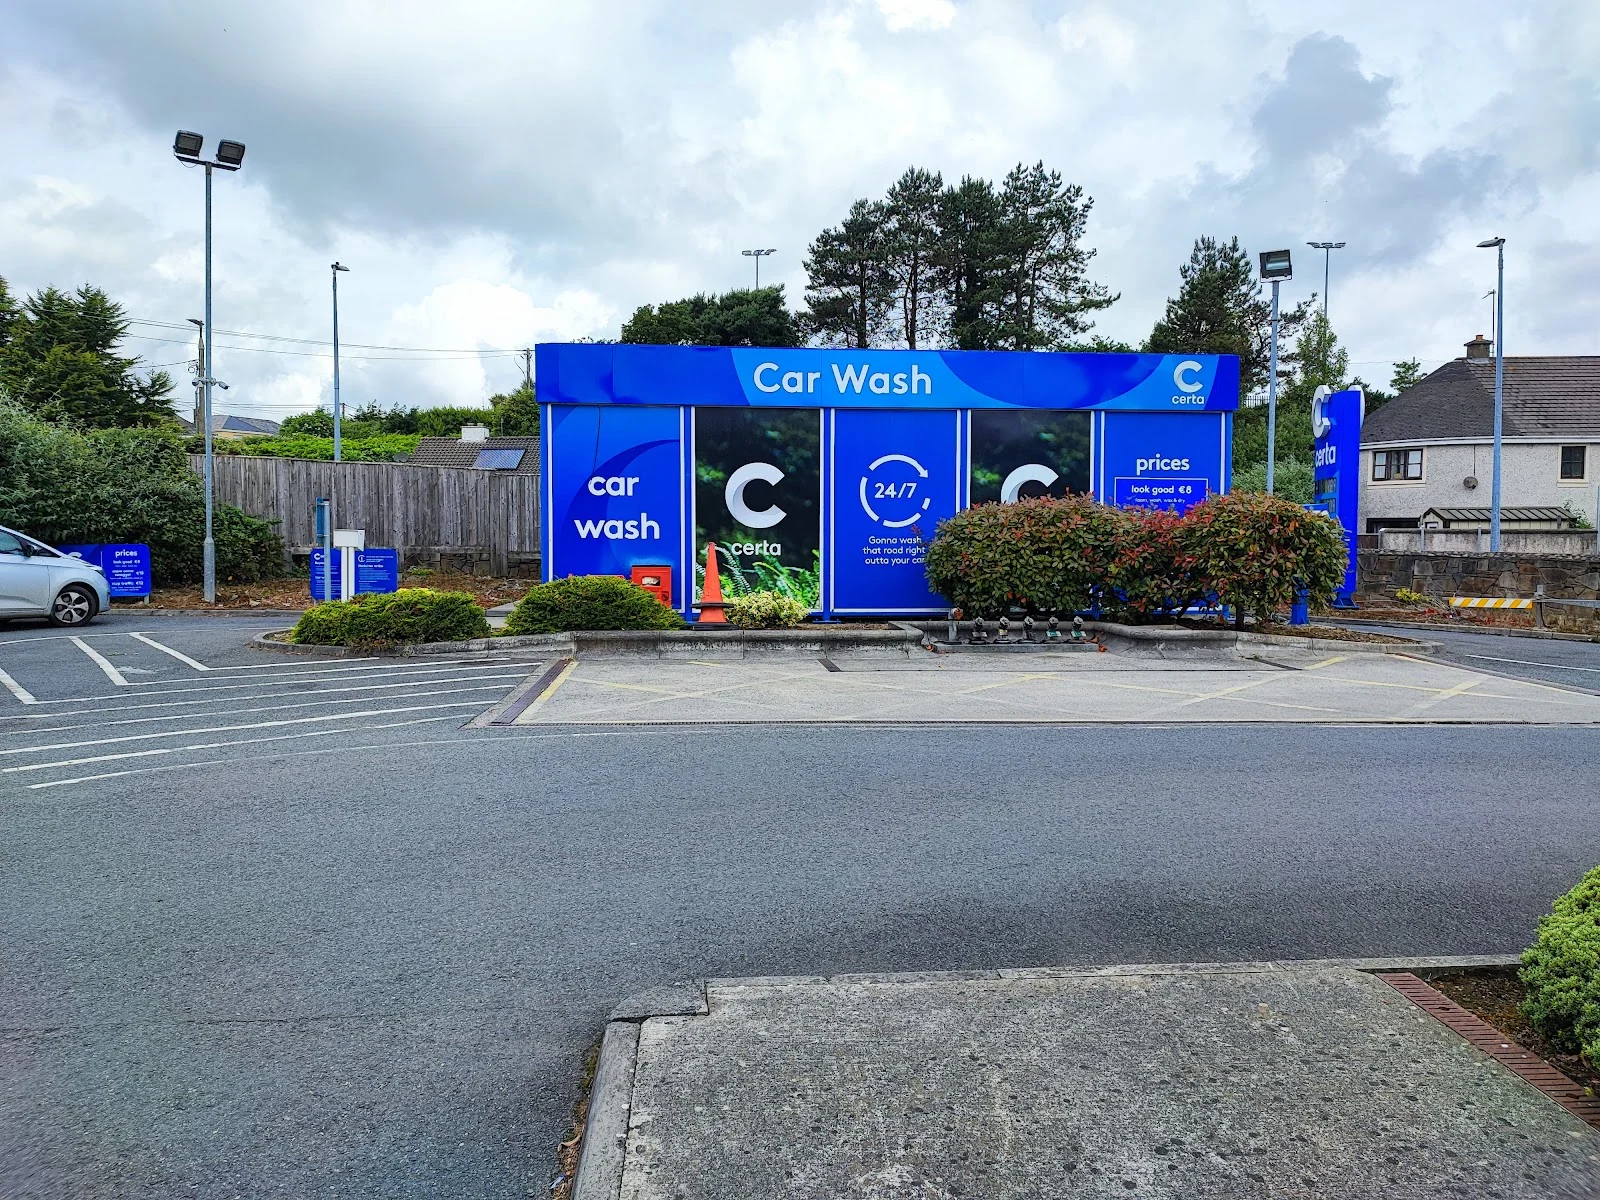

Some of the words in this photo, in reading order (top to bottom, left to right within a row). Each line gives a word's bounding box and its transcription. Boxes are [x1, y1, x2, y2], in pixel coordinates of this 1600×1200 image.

[753, 362, 820, 393] Car
[831, 364, 932, 394] Wash
[1171, 394, 1205, 405] certa
[1136, 453, 1190, 476] prices
[588, 476, 639, 497] car
[874, 482, 917, 499] 24/7
[1131, 484, 1150, 494] look
[1152, 485, 1175, 496] good
[1178, 485, 1192, 494] €8
[573, 512, 660, 540] wash
[868, 535, 898, 545] Gonna
[899, 535, 922, 544] wash
[115, 549, 138, 558] prices
[731, 540, 782, 556] certa
[862, 545, 881, 555] that
[883, 545, 904, 555] road
[905, 545, 926, 557] right
[864, 557, 889, 565] outta
[890, 557, 910, 567] your
